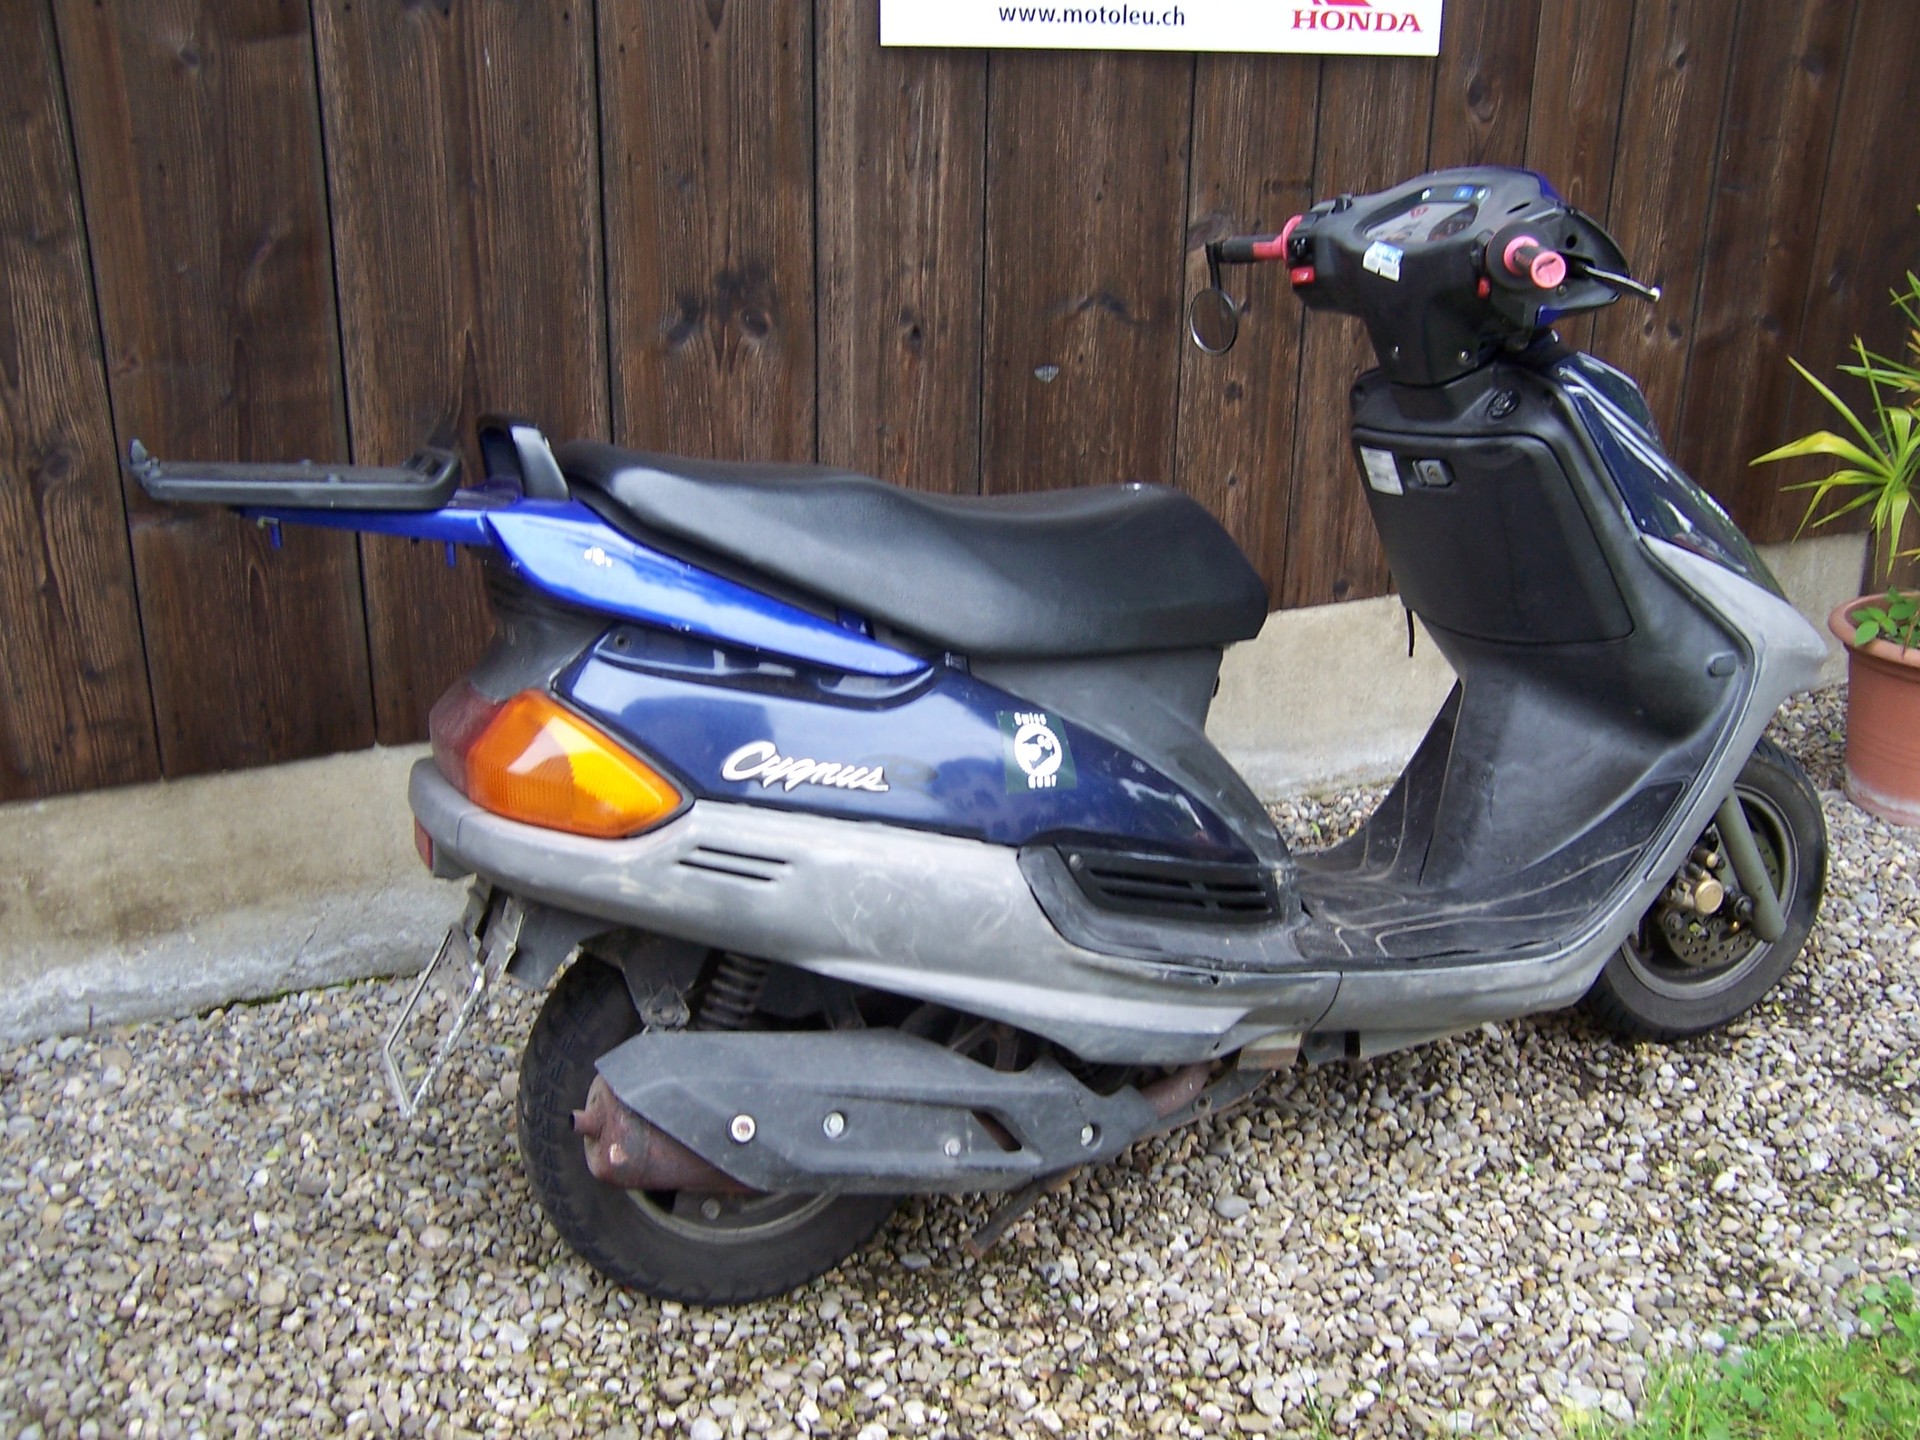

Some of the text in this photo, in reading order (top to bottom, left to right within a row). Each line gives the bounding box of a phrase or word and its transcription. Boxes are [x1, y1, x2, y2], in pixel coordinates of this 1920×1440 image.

[999, 3, 1185, 26] www.motoleu.ch
[1291, 9, 1423, 32] HONDA
[722, 740, 890, 792] Cygnus
